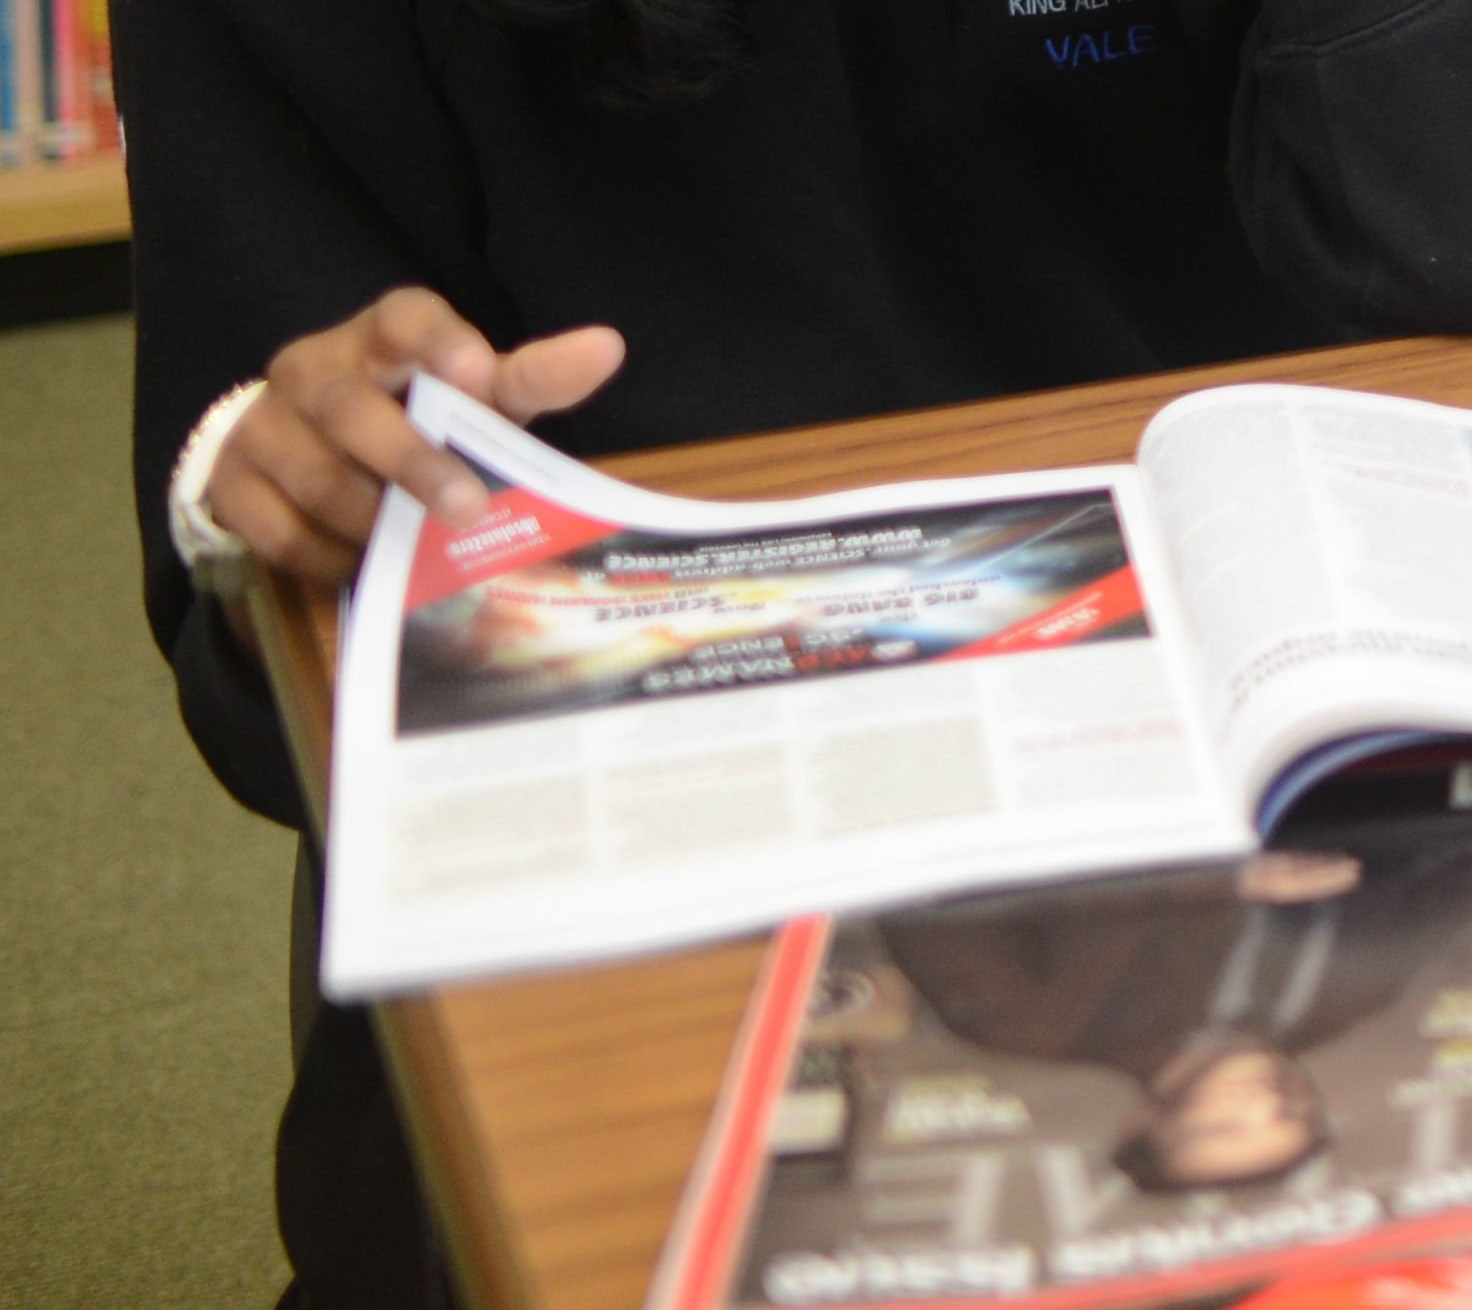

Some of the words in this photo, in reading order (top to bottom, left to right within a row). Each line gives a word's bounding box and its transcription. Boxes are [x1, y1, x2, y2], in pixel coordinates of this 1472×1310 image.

[1044, 23, 1157, 68] VALE
[1048, 1186, 1383, 1280] Genius
[762, 1242, 1040, 1306] Issue
